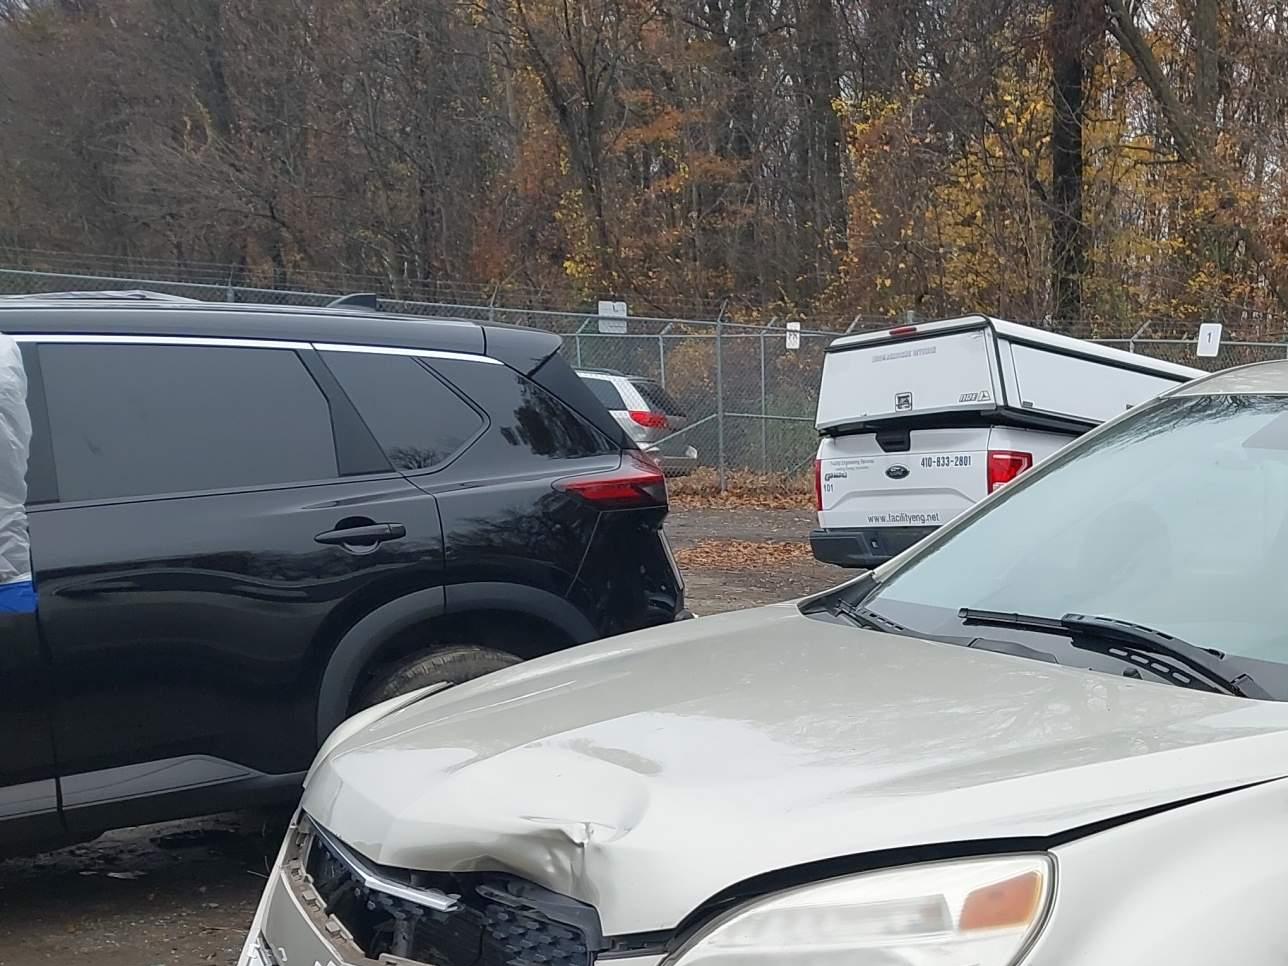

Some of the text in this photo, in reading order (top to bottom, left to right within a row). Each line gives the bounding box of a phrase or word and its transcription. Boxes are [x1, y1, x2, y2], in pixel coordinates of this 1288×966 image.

[1207, 332, 1212, 345] 1
[920, 456, 972, 468] 410-833-2801
[867, 512, 940, 524] www.facilityeng.net
